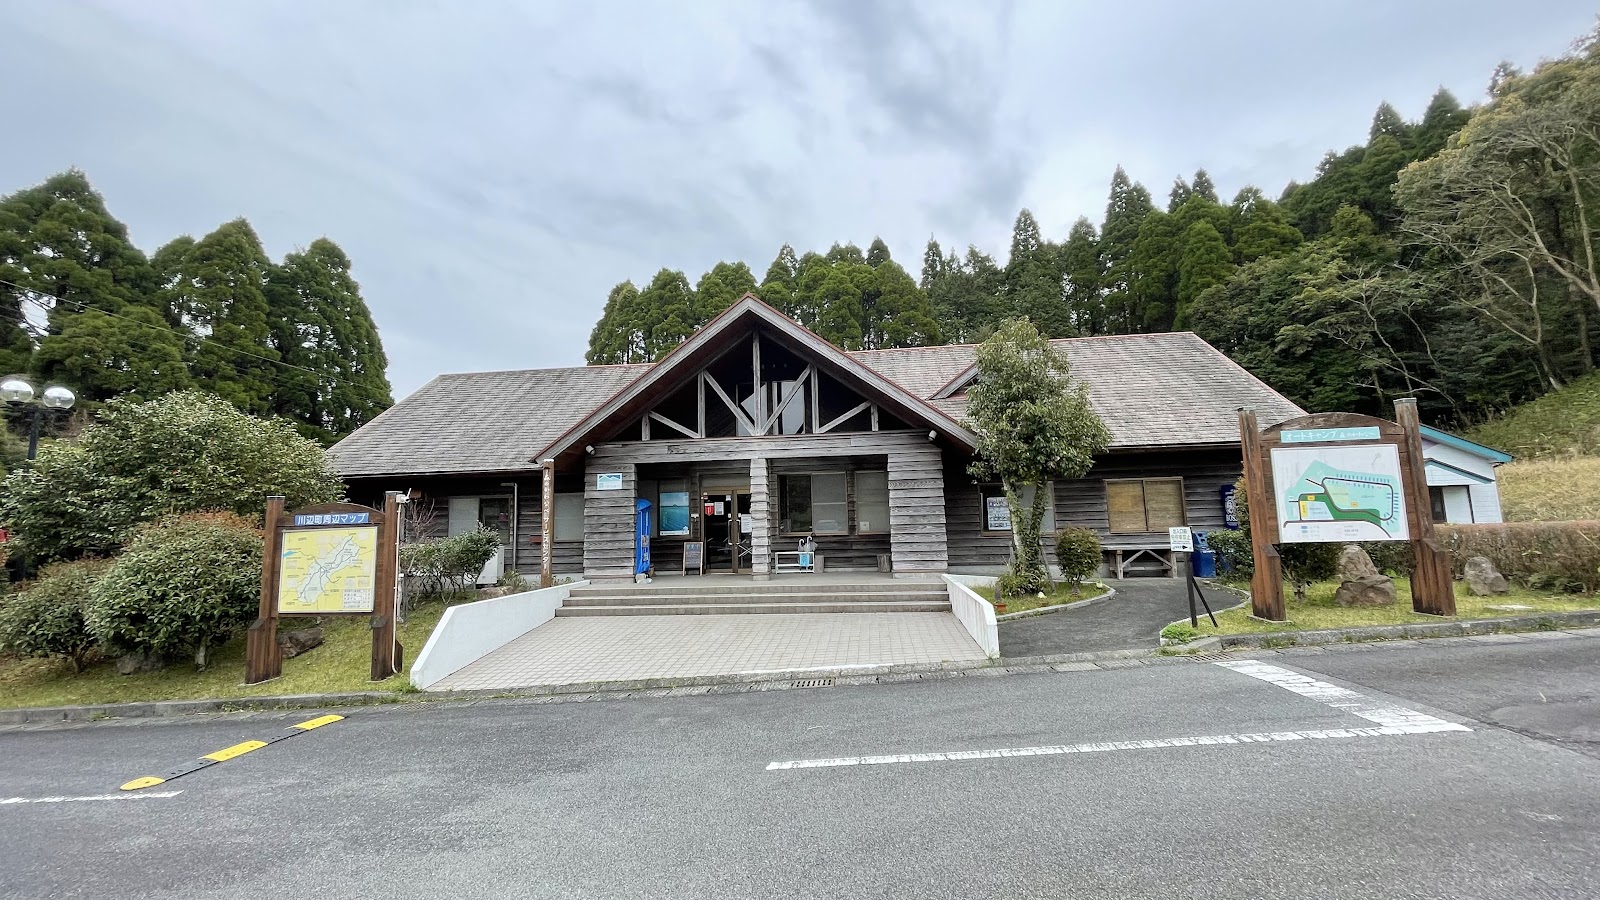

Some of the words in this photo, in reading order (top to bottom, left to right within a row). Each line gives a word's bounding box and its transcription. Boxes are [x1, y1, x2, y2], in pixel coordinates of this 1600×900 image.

[1286, 430, 1337, 441] オートキャンプ
[297, 513, 366, 525] 川辺町周辺マップ
